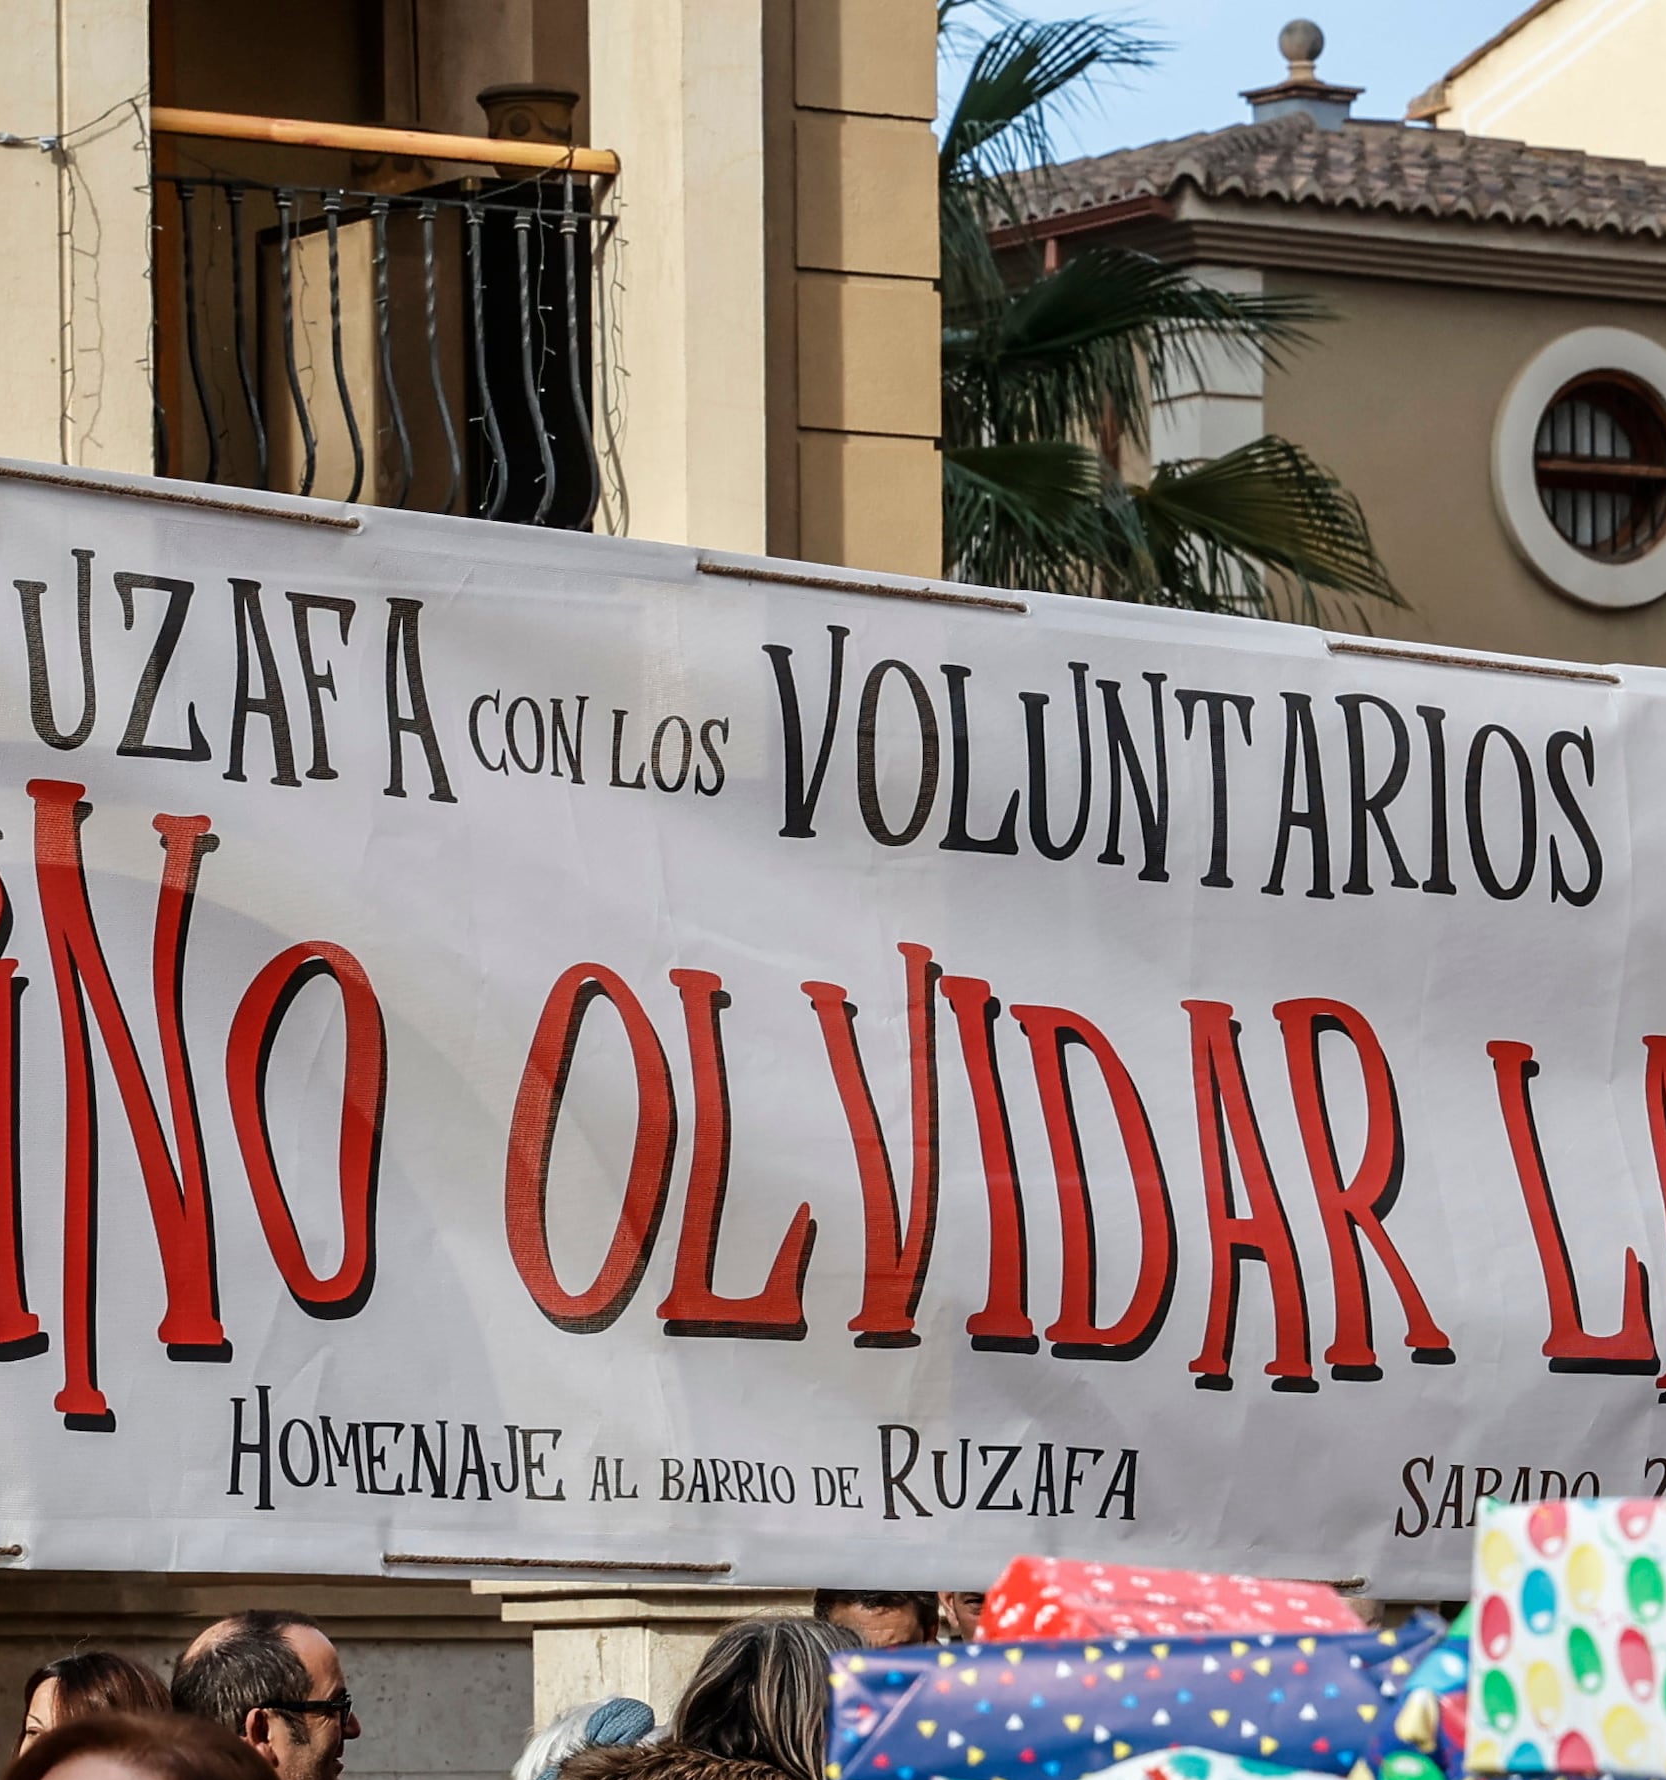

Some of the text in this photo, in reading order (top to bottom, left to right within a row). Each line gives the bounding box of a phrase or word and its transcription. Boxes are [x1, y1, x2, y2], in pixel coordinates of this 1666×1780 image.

[468, 690, 590, 785] CON
[609, 709, 729, 797] LOS
[762, 625, 1603, 907] VOLUNTARIOS
[505, 942, 1457, 1391] OLVIDAR
[225, 1385, 1140, 1521] HOMENAJE AL BARRIO DE RUZAFA
